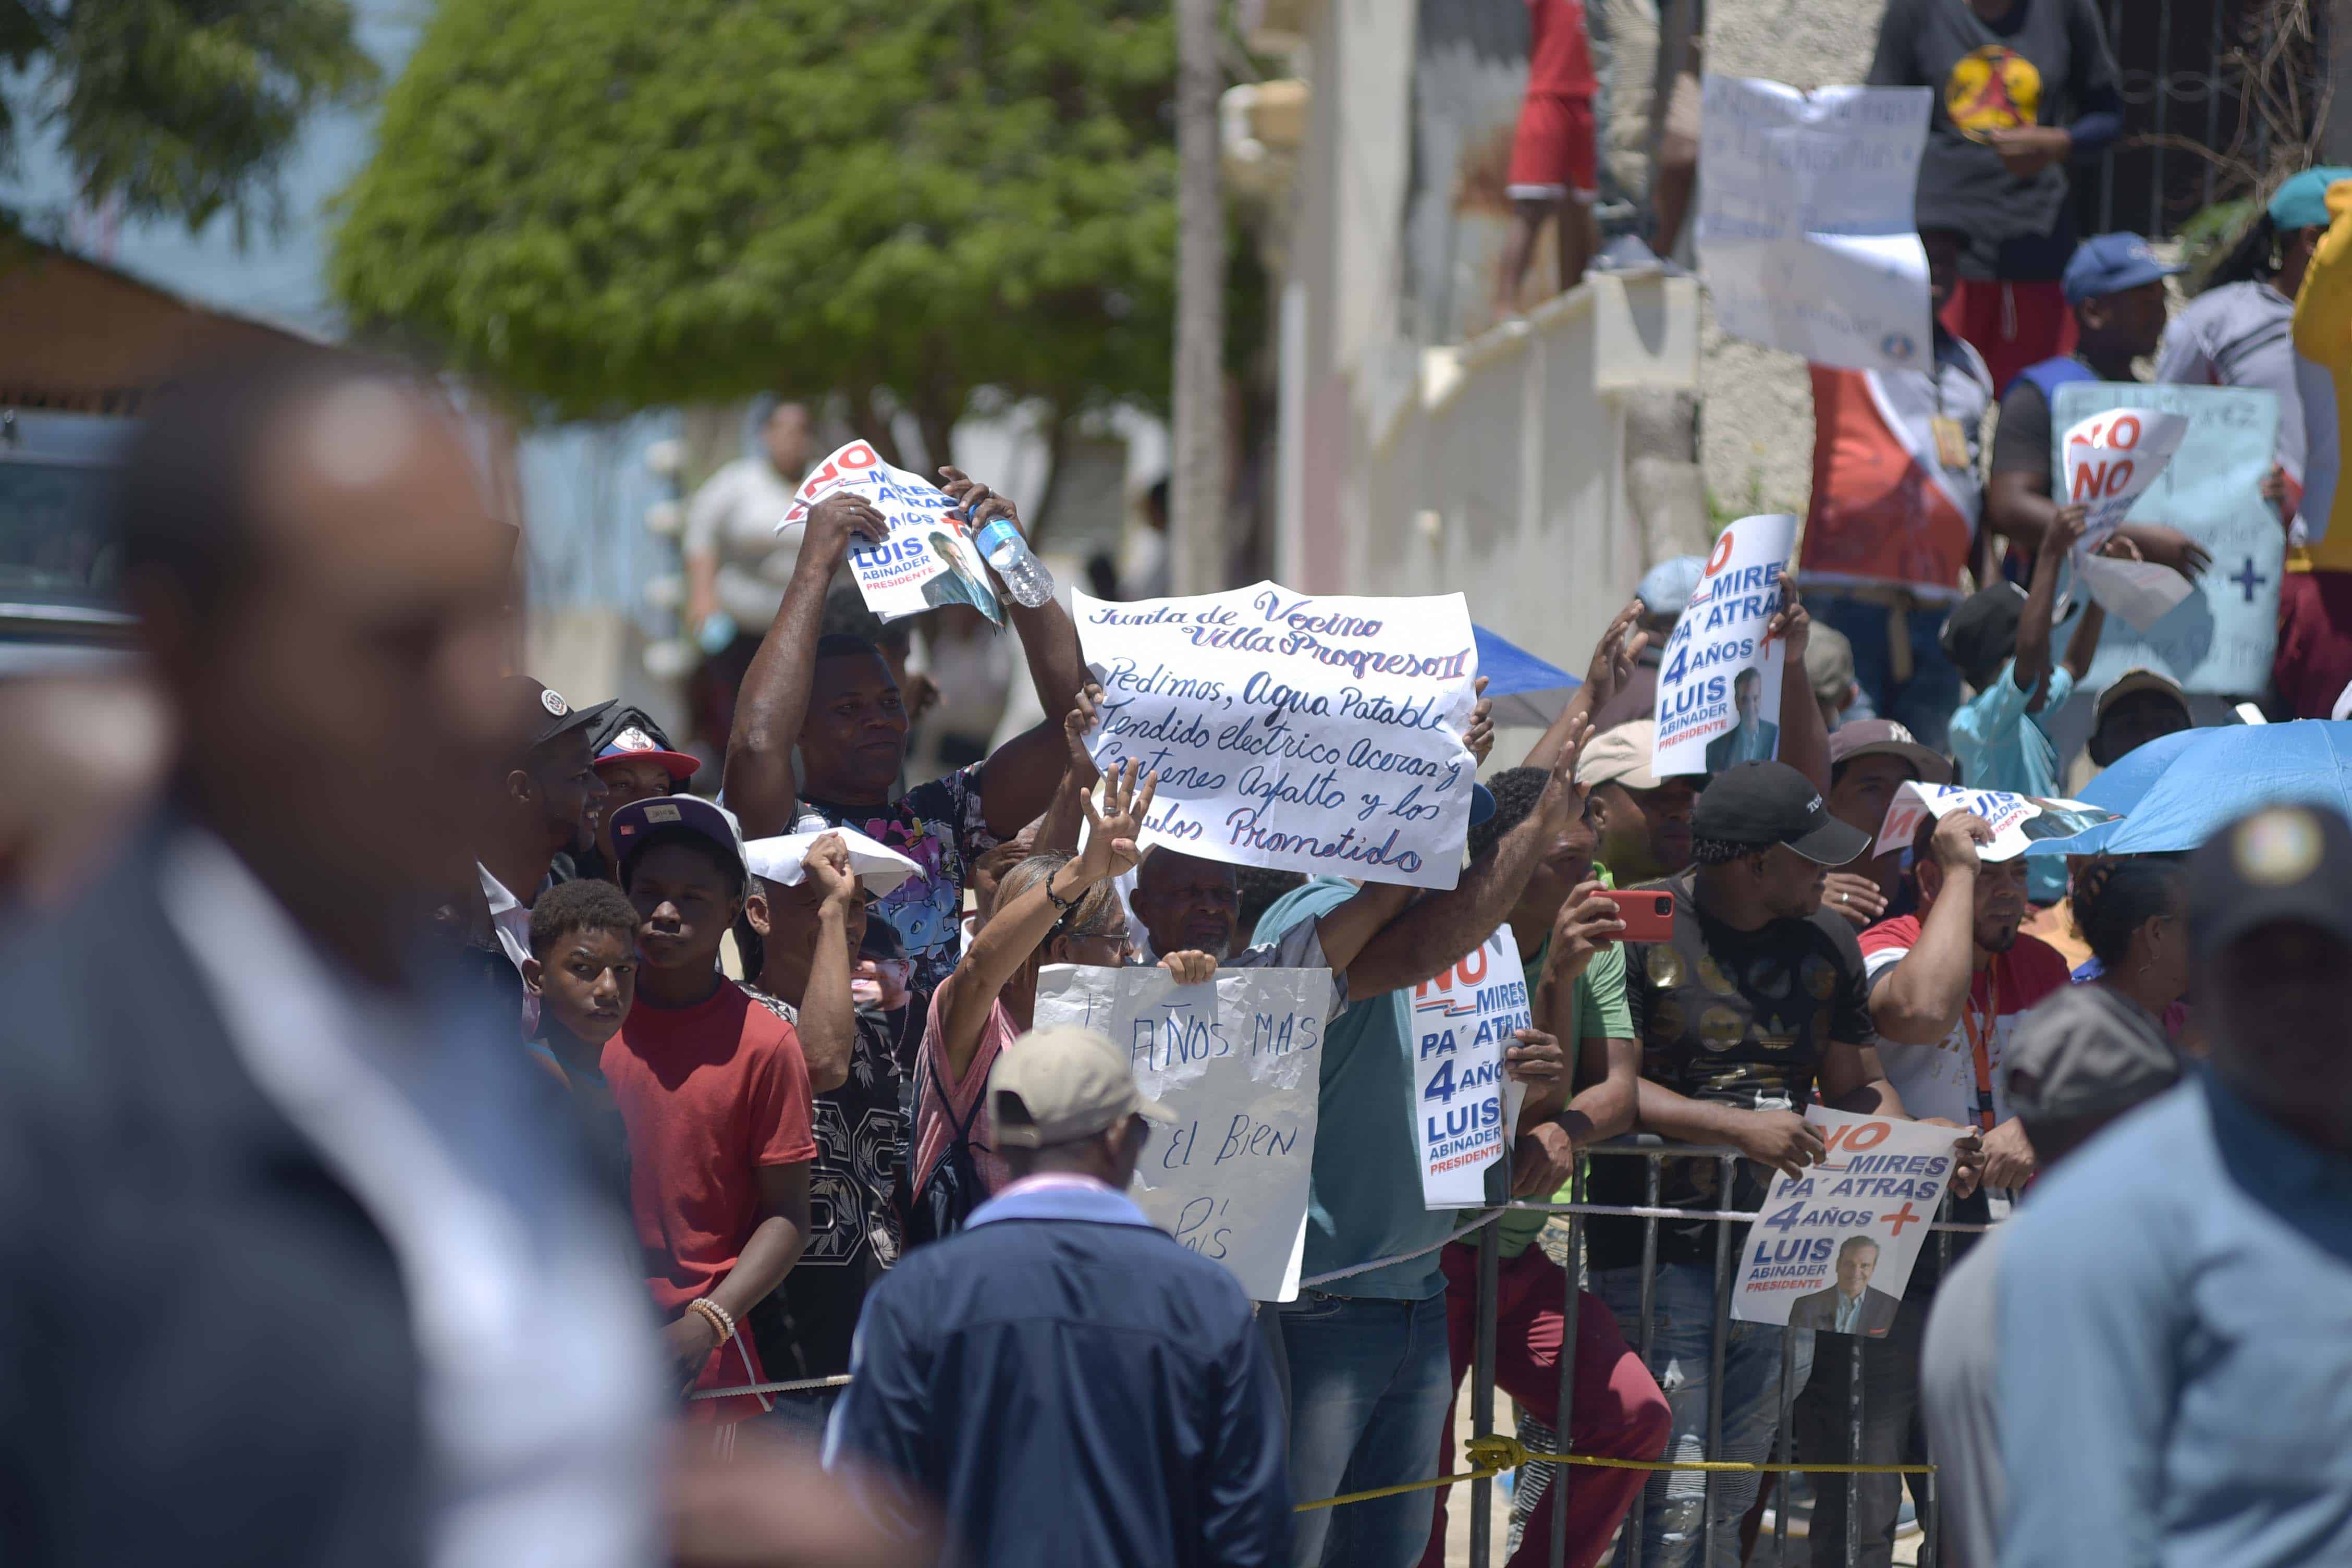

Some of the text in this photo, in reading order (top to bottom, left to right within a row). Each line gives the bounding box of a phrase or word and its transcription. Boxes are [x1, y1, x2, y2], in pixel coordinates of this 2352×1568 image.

[804, 444, 877, 499] NO
[2073, 460, 2134, 501] NO
[853, 537, 923, 570] LUIS
[863, 555, 930, 580] ABINADER
[1705, 531, 1735, 579] O
[866, 566, 936, 591] PRESIDENTE
[1196, 605, 1239, 626] de
[1254, 591, 1383, 637] Vecino
[1181, 626, 1276, 653] Villa
[1663, 644, 1689, 687] 4
[1690, 638, 1754, 673] AÑOS
[1106, 657, 1233, 710] Pedimos,
[1660, 676, 1726, 725] LUIS
[1101, 697, 1210, 748] Tendido
[1659, 703, 1728, 740] ABINADER
[1659, 719, 1727, 752] PRESIDENTE
[1358, 792, 1387, 821] y
[1388, 785, 1440, 820] los
[1969, 791, 2015, 817] UIS
[1226, 808, 1422, 873] Prometido
[1476, 981, 1527, 1016] MIRES
[1252, 1012, 1318, 1057] MAS
[1473, 1010, 1532, 1049] ATRAS
[1424, 1057, 1504, 1105] 4 AÑO
[1428, 1096, 1500, 1146] LUIS
[1429, 1126, 1502, 1163] ABINADER
[1430, 1143, 1502, 1177] PRESIDENTE
[1844, 1155, 1950, 1178] MIRES
[1828, 1178, 1940, 1200] ATRAS
[1763, 1200, 1807, 1234] 4
[1798, 1207, 1875, 1227] AÑOS
[1752, 1237, 1835, 1266] LUIS
[1745, 1278, 1823, 1294] PRESIDENTE
[1748, 1265, 1828, 1281] ABINADER
